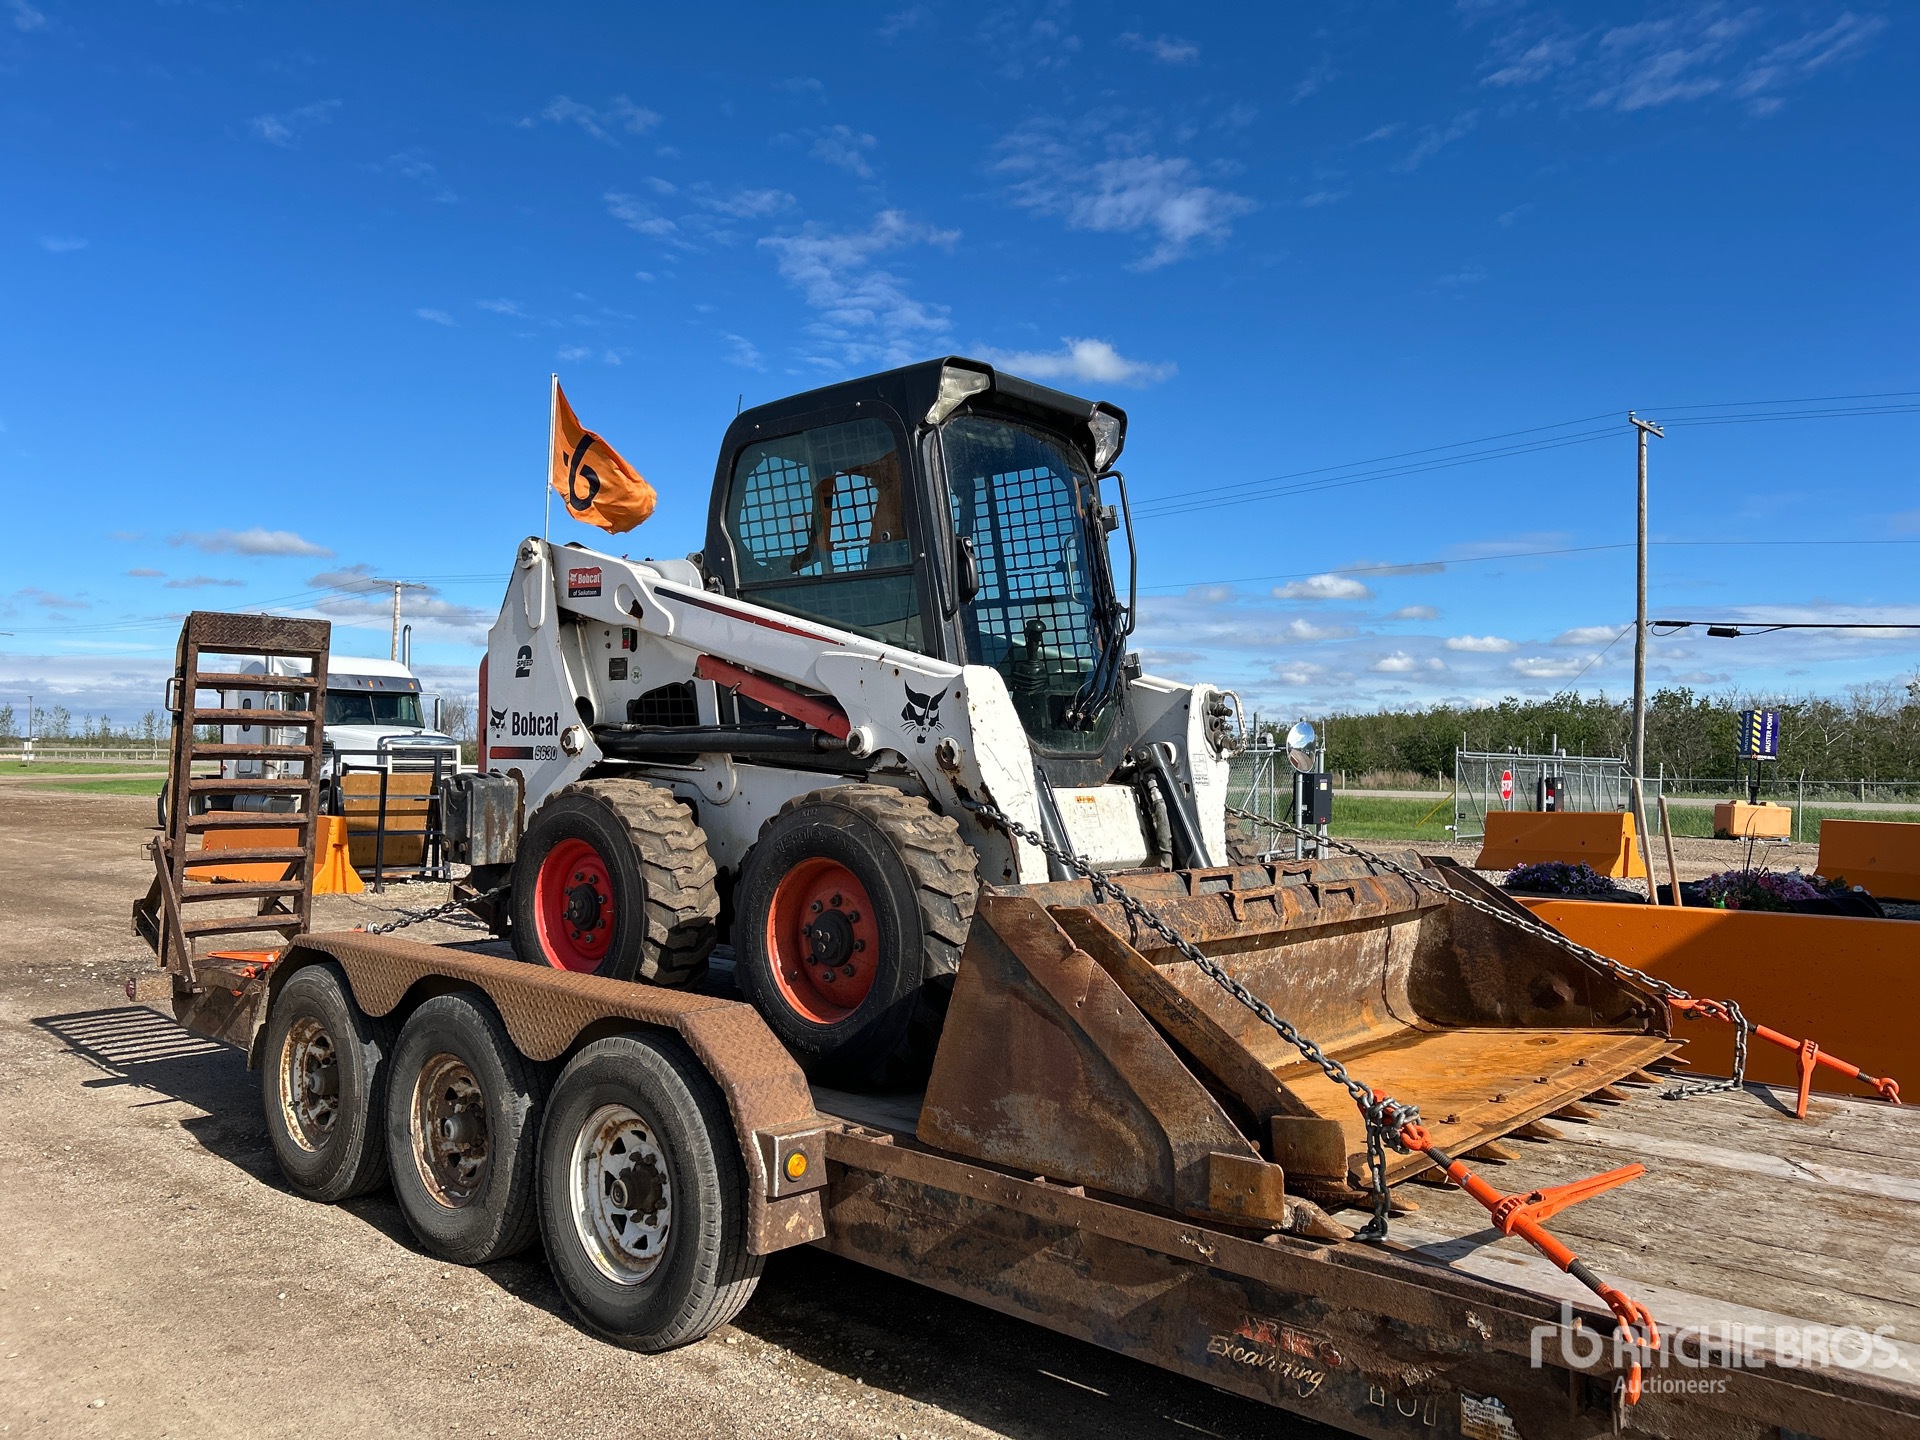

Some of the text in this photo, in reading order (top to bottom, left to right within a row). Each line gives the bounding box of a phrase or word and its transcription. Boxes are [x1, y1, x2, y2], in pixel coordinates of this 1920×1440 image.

[577, 573, 600, 584] Bobcat
[511, 711, 559, 737] Bobcat
[534, 745, 558, 761] S630
[1501, 780, 1512, 792] STOP
